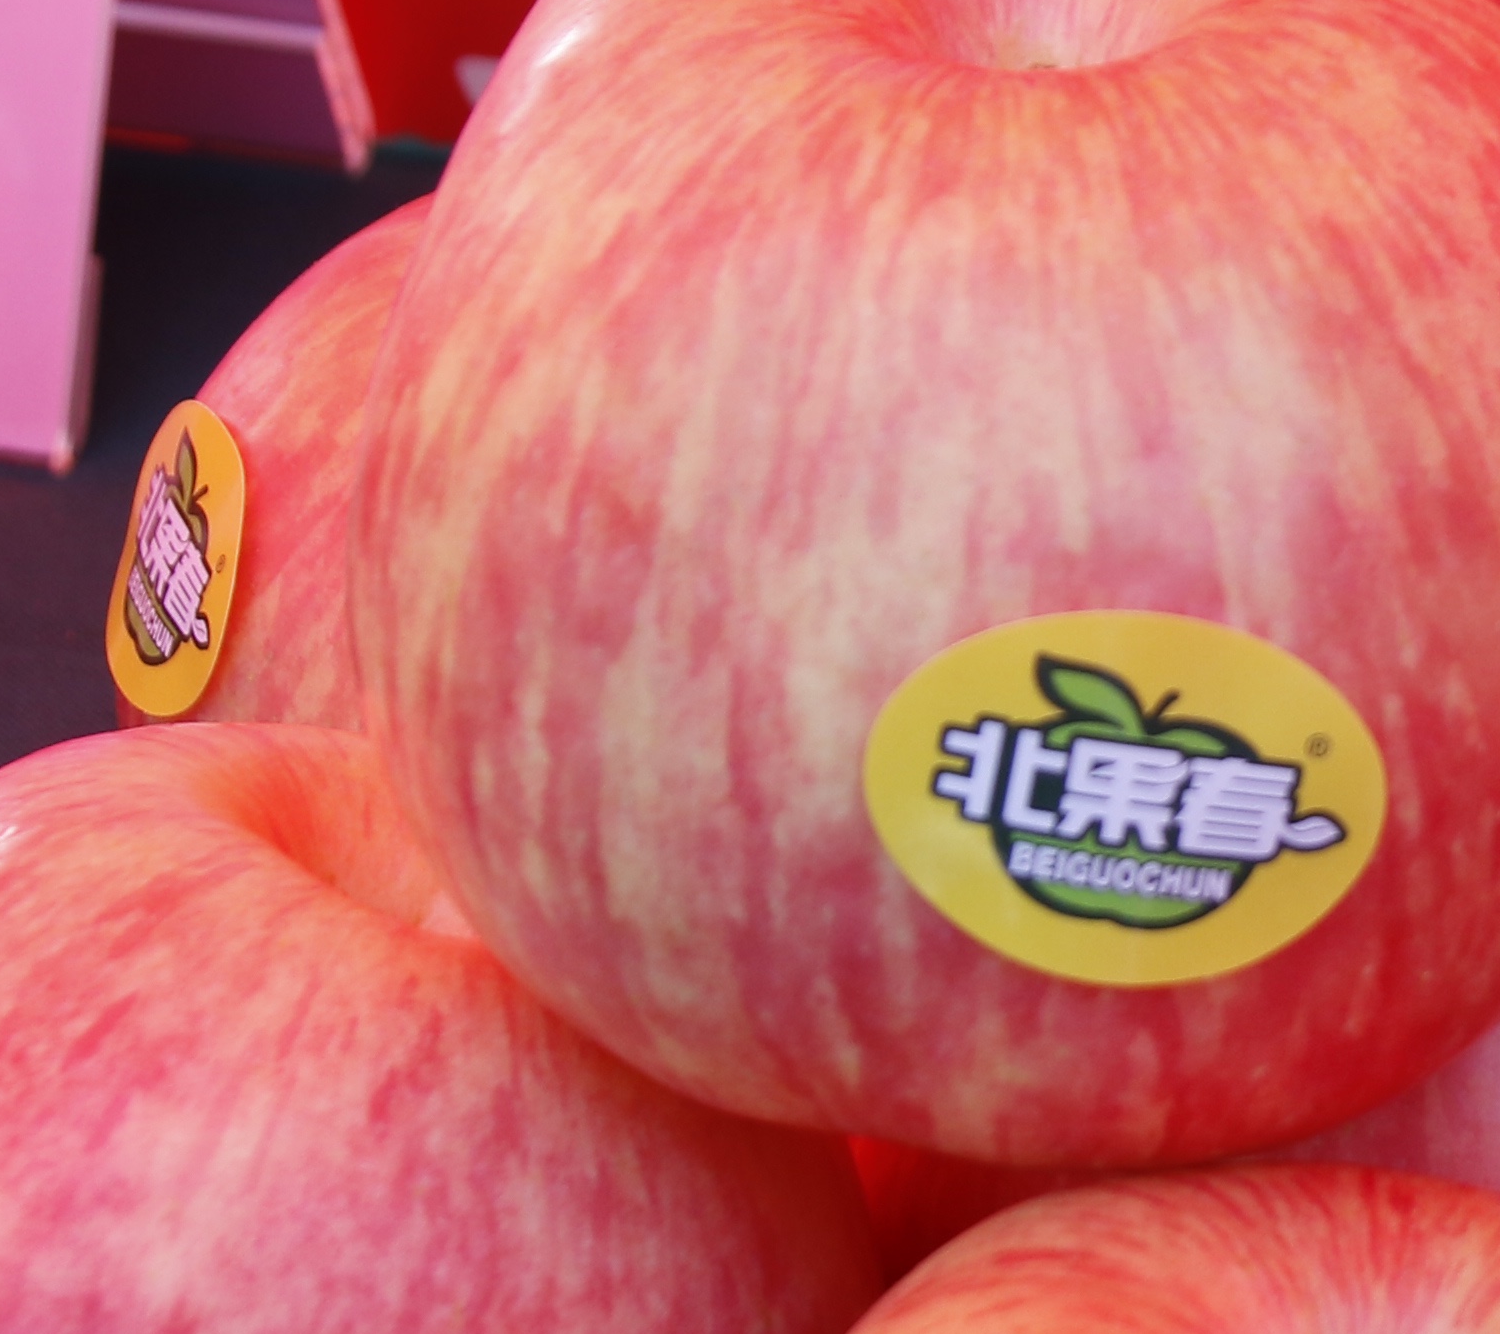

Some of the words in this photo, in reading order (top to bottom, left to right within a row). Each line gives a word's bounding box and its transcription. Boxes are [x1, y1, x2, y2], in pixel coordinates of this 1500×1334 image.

[933, 719, 1343, 863] 北果春
[1006, 840, 1234, 904] BEIGUOCHUN
